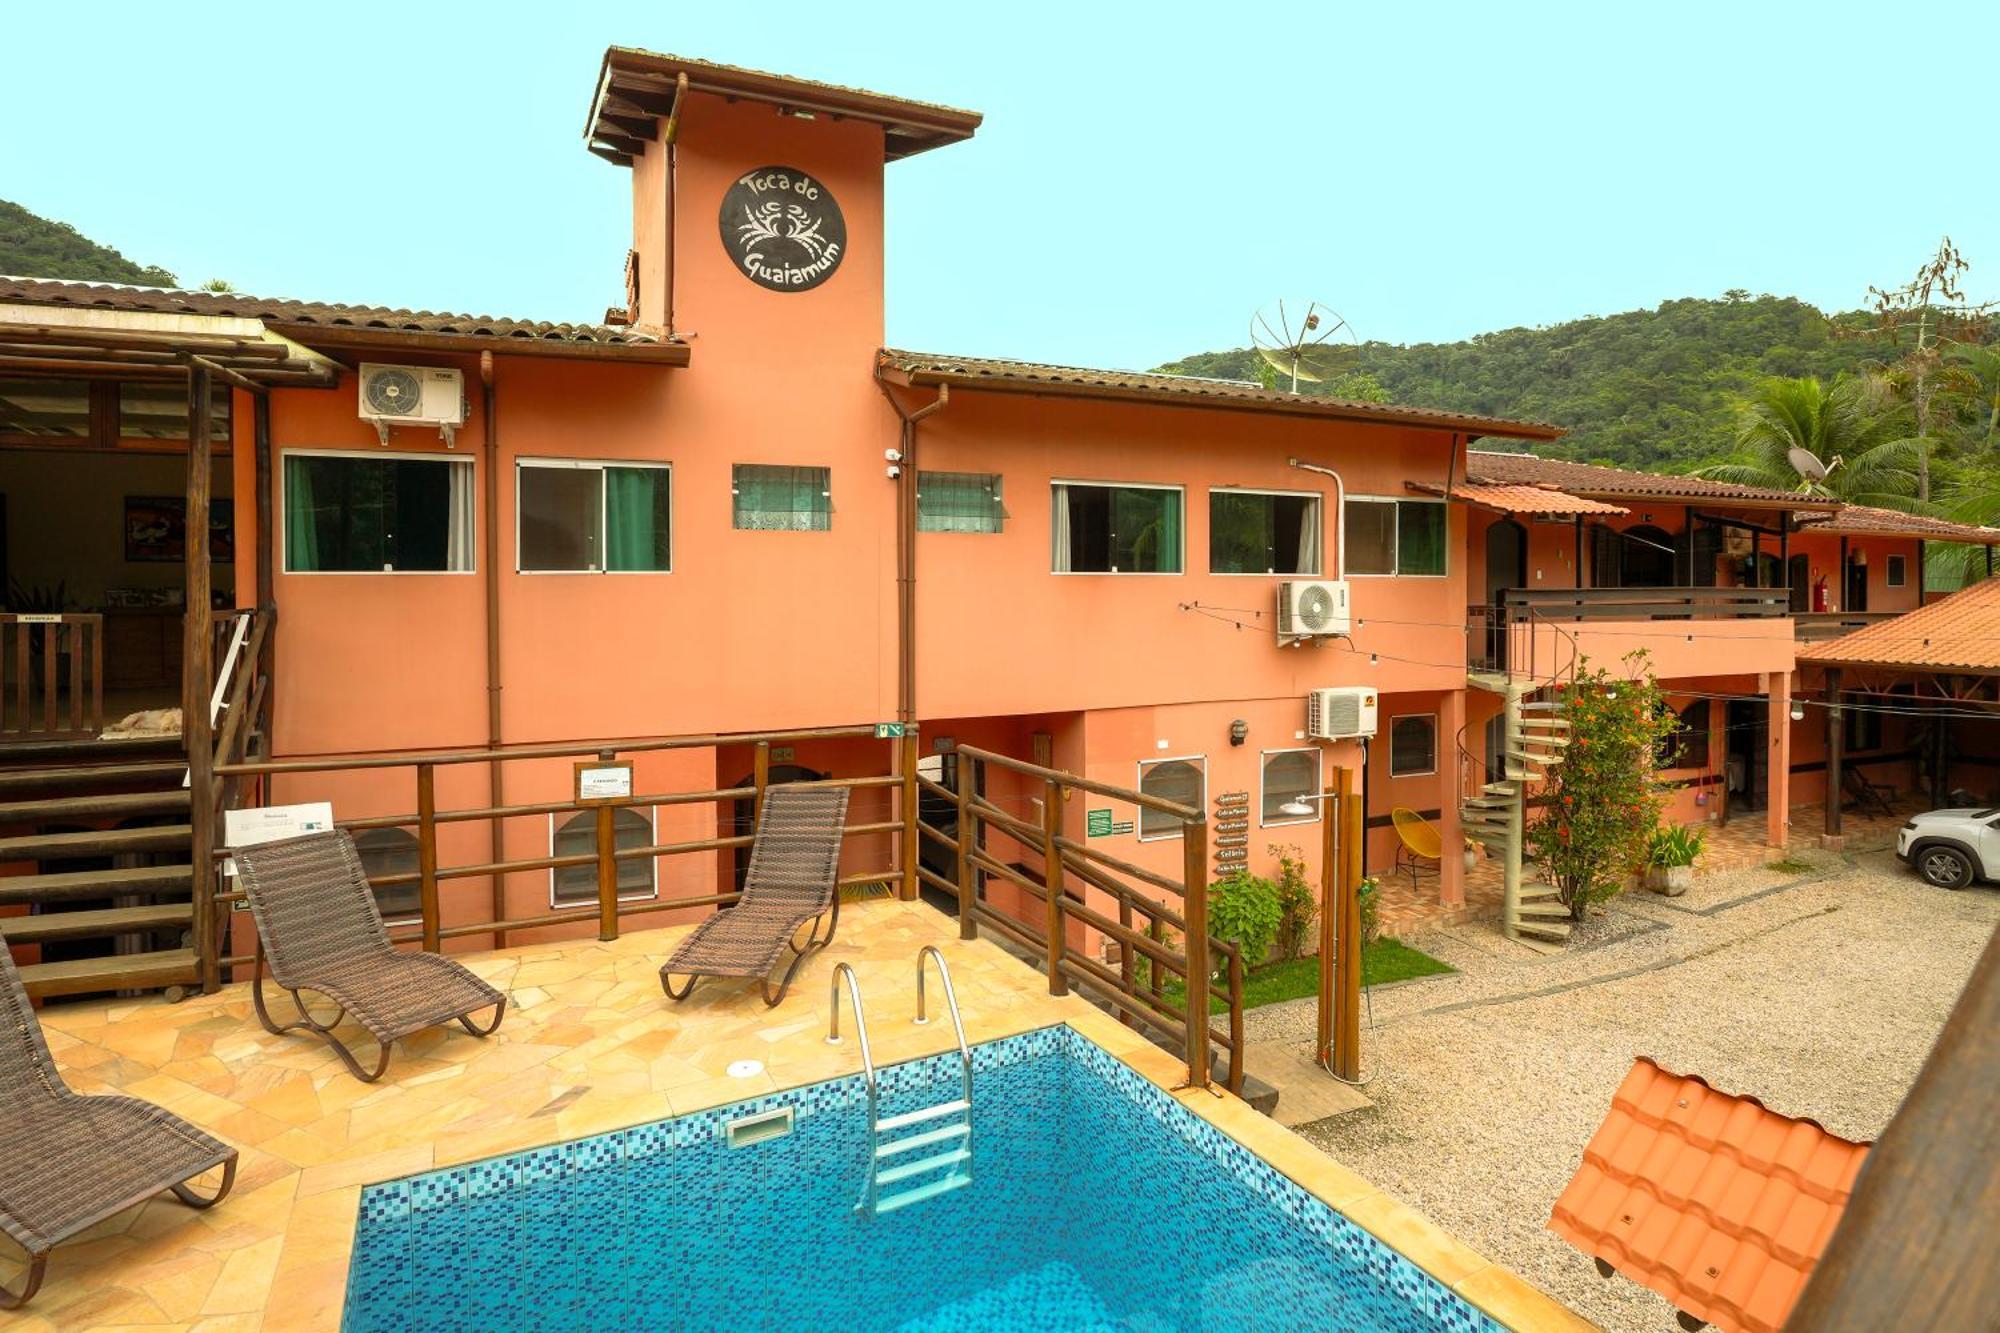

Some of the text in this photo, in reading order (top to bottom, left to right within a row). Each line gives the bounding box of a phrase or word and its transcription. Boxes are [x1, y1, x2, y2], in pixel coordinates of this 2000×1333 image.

[739, 172, 818, 200] Toca do
[743, 243, 840, 284] Guaiamum
